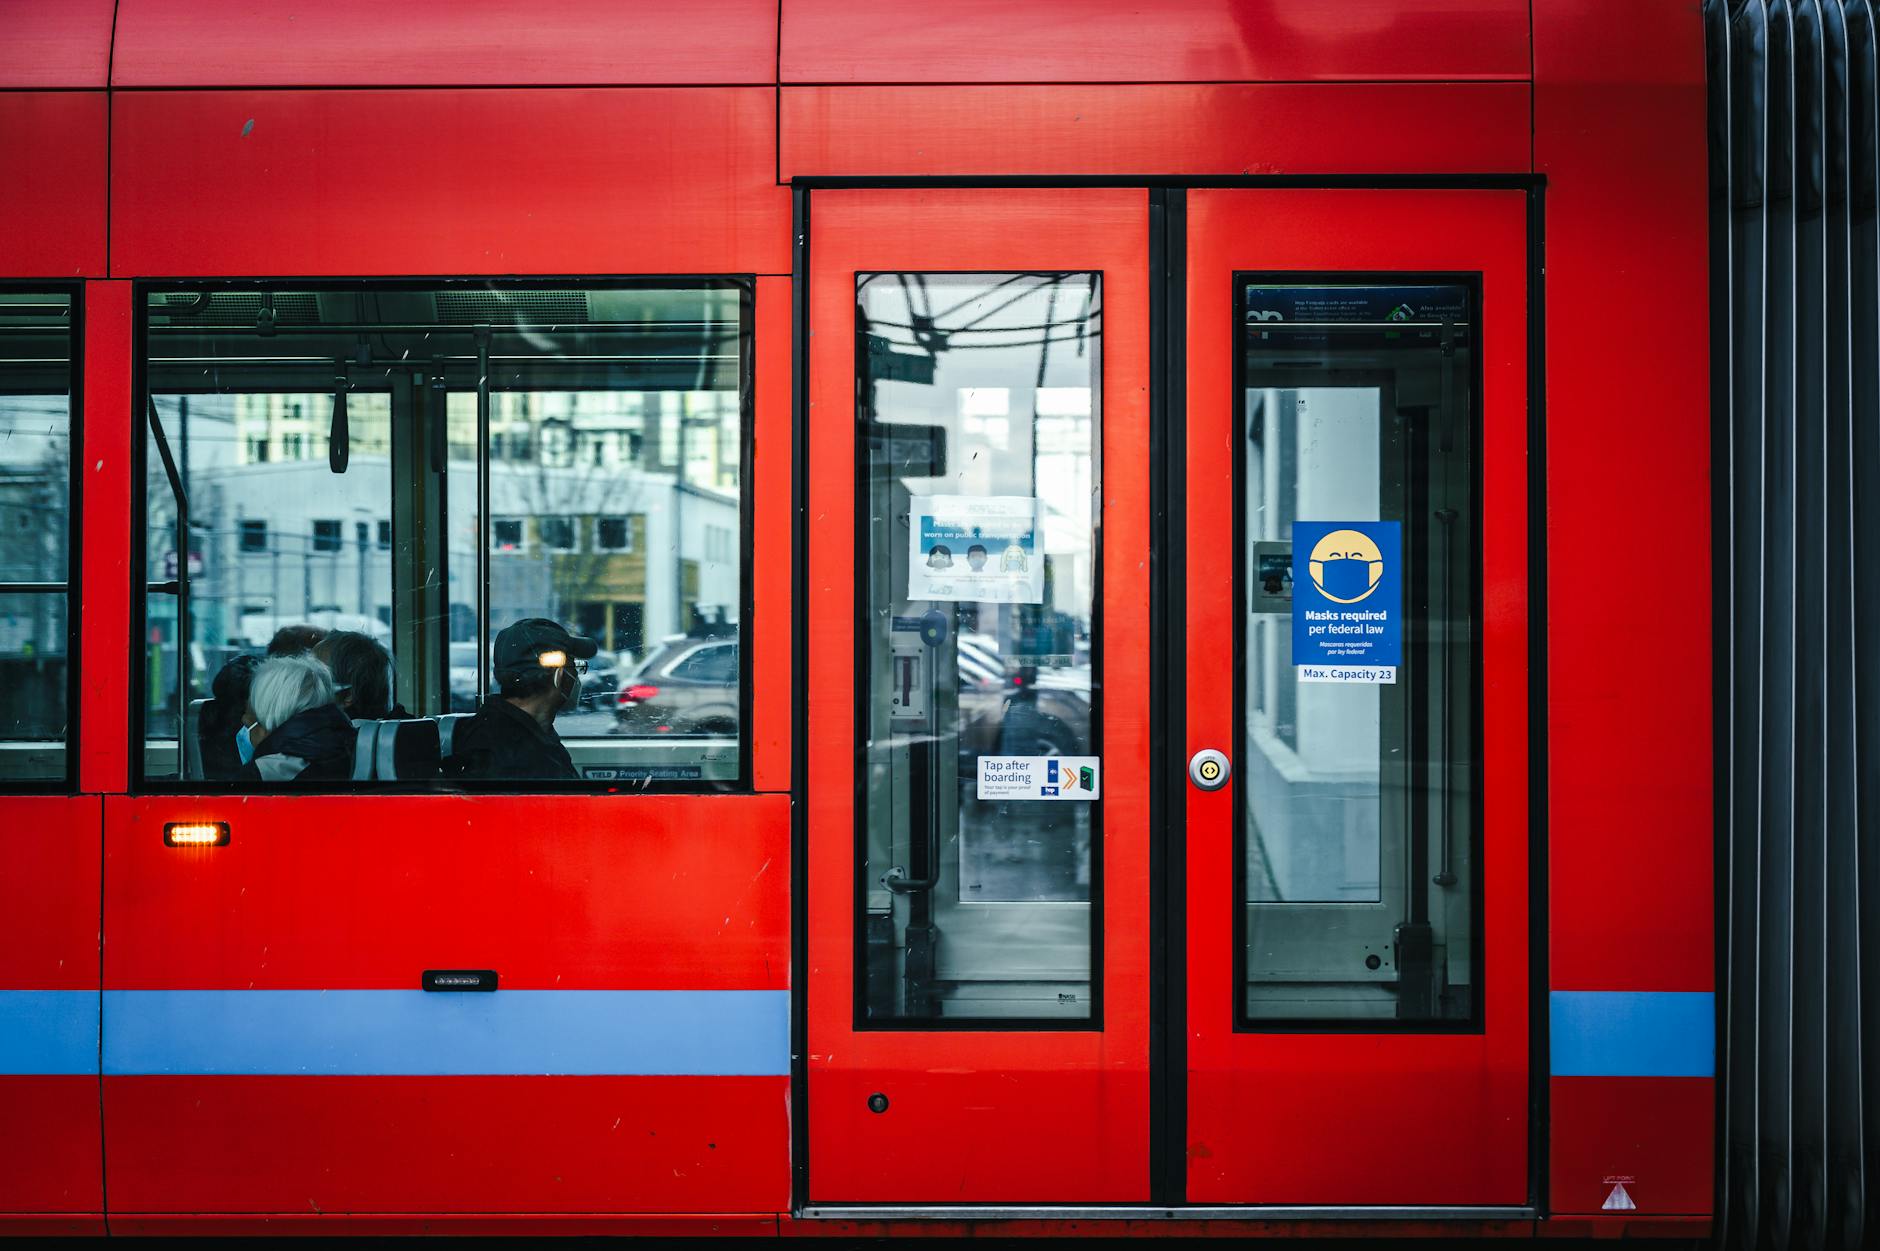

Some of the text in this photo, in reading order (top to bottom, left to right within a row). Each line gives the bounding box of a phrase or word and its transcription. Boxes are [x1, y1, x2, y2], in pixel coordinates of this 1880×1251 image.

[1305, 610, 1387, 622] Masks required
[1309, 624, 1384, 636] per federal law
[1303, 669, 1392, 681] Max. Capacity 23
[984, 760, 1030, 772] Tap after
[620, 770, 647, 778] Priority
[649, 769, 678, 778] Seating
[984, 772, 1031, 784] boarding
